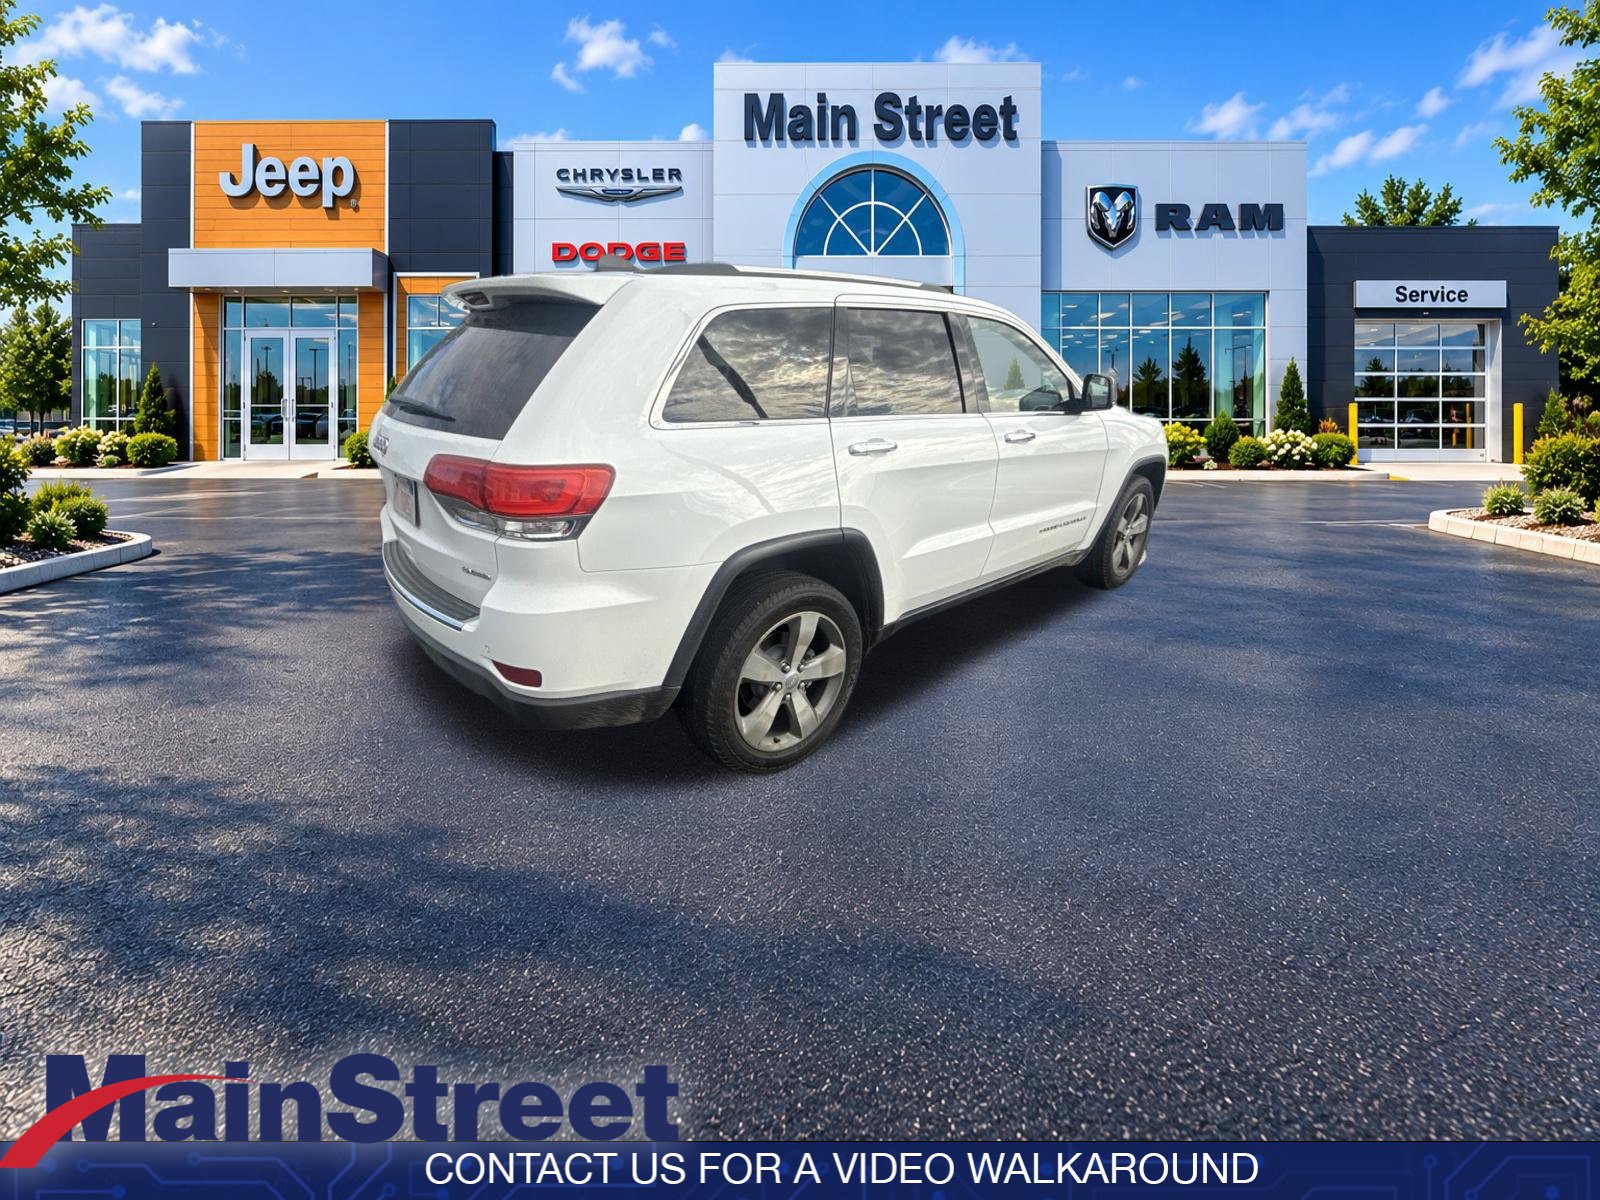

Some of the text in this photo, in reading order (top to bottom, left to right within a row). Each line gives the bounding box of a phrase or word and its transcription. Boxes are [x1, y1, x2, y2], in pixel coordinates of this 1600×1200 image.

[744, 92, 1017, 141] Main Street
[219, 143, 354, 208] Jeep
[556, 168, 683, 182] CHRYSLER
[1155, 203, 1284, 231] RAM
[552, 242, 686, 261] DODGE
[1395, 285, 1469, 303] Service
